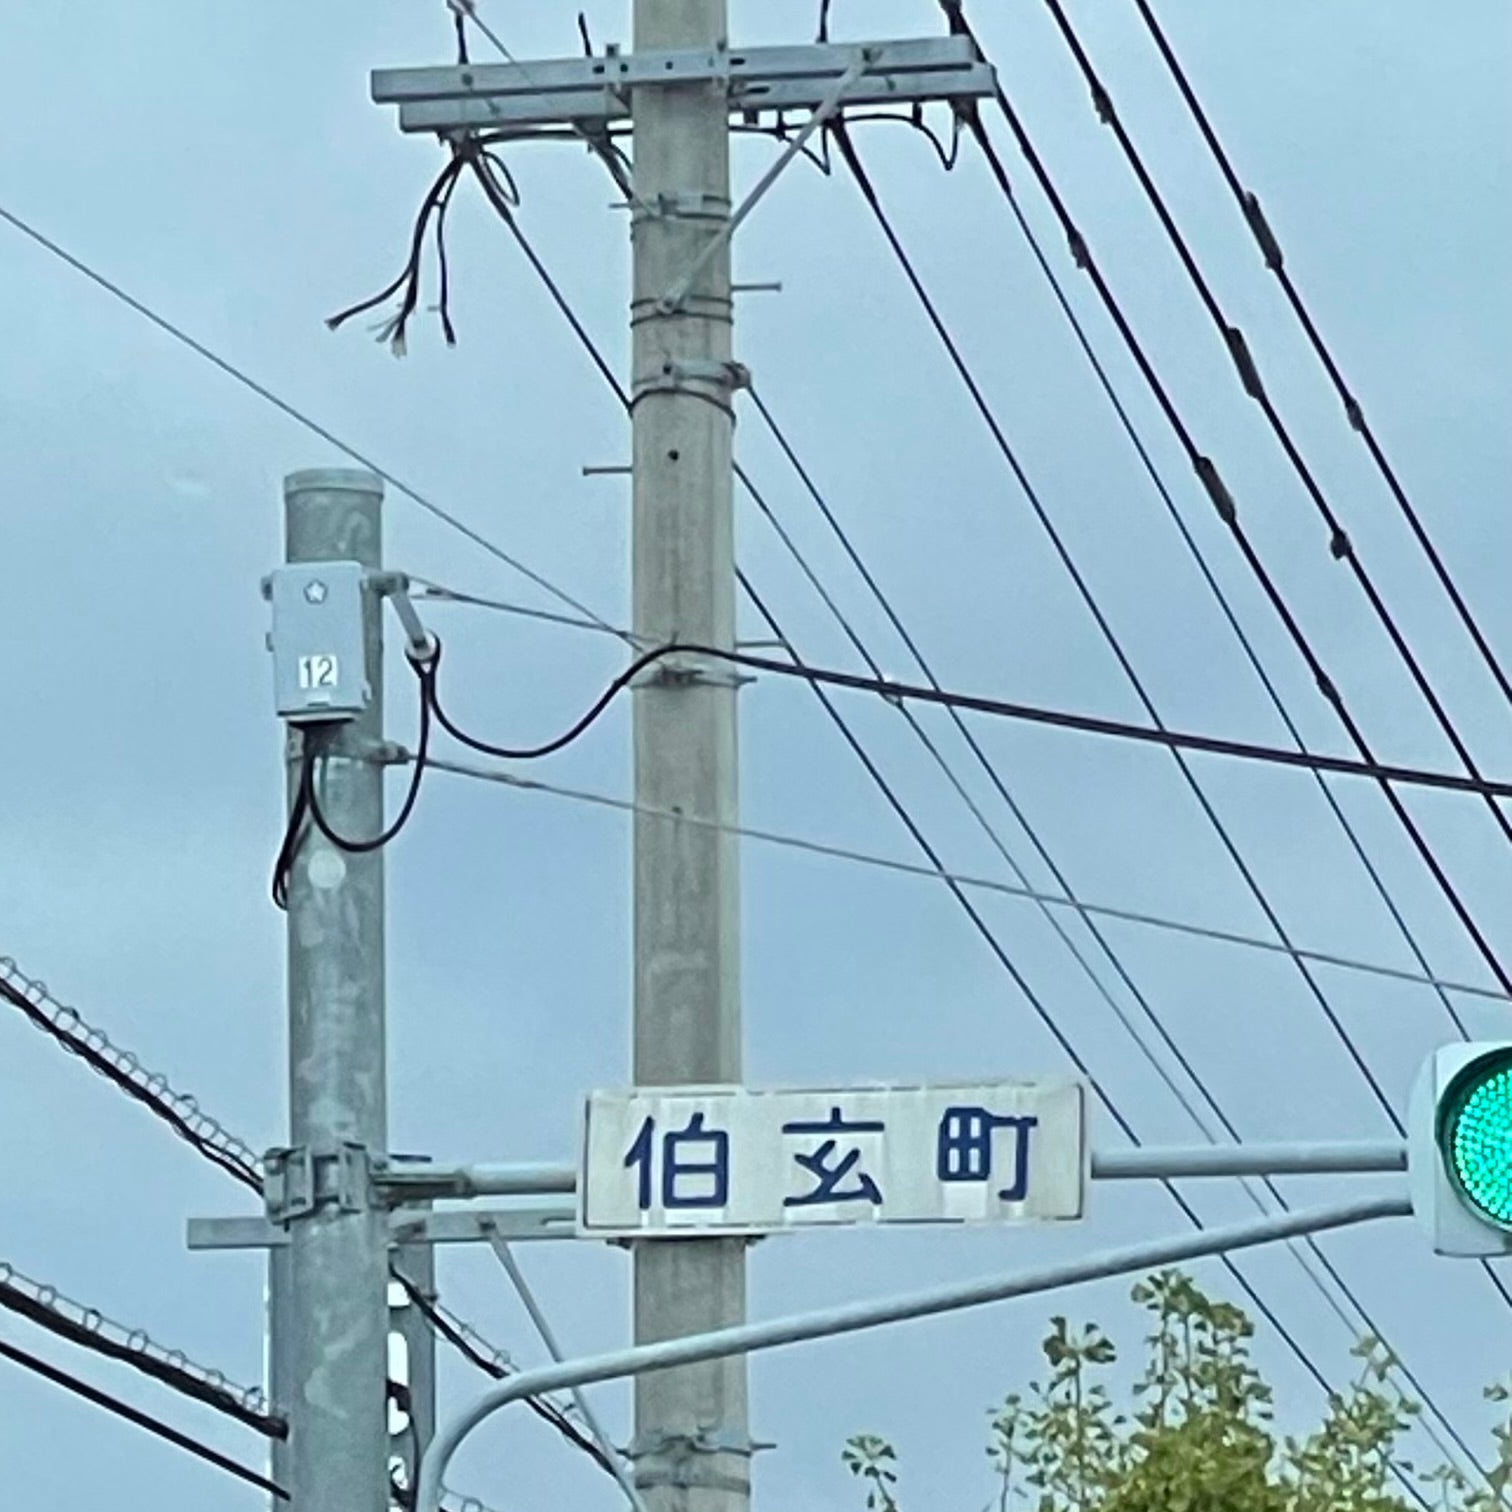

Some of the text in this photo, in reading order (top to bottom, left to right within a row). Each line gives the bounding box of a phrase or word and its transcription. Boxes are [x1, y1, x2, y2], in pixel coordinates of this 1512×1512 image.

[303, 656, 334, 687] 12
[624, 1105, 1038, 1209] 伯玄町
